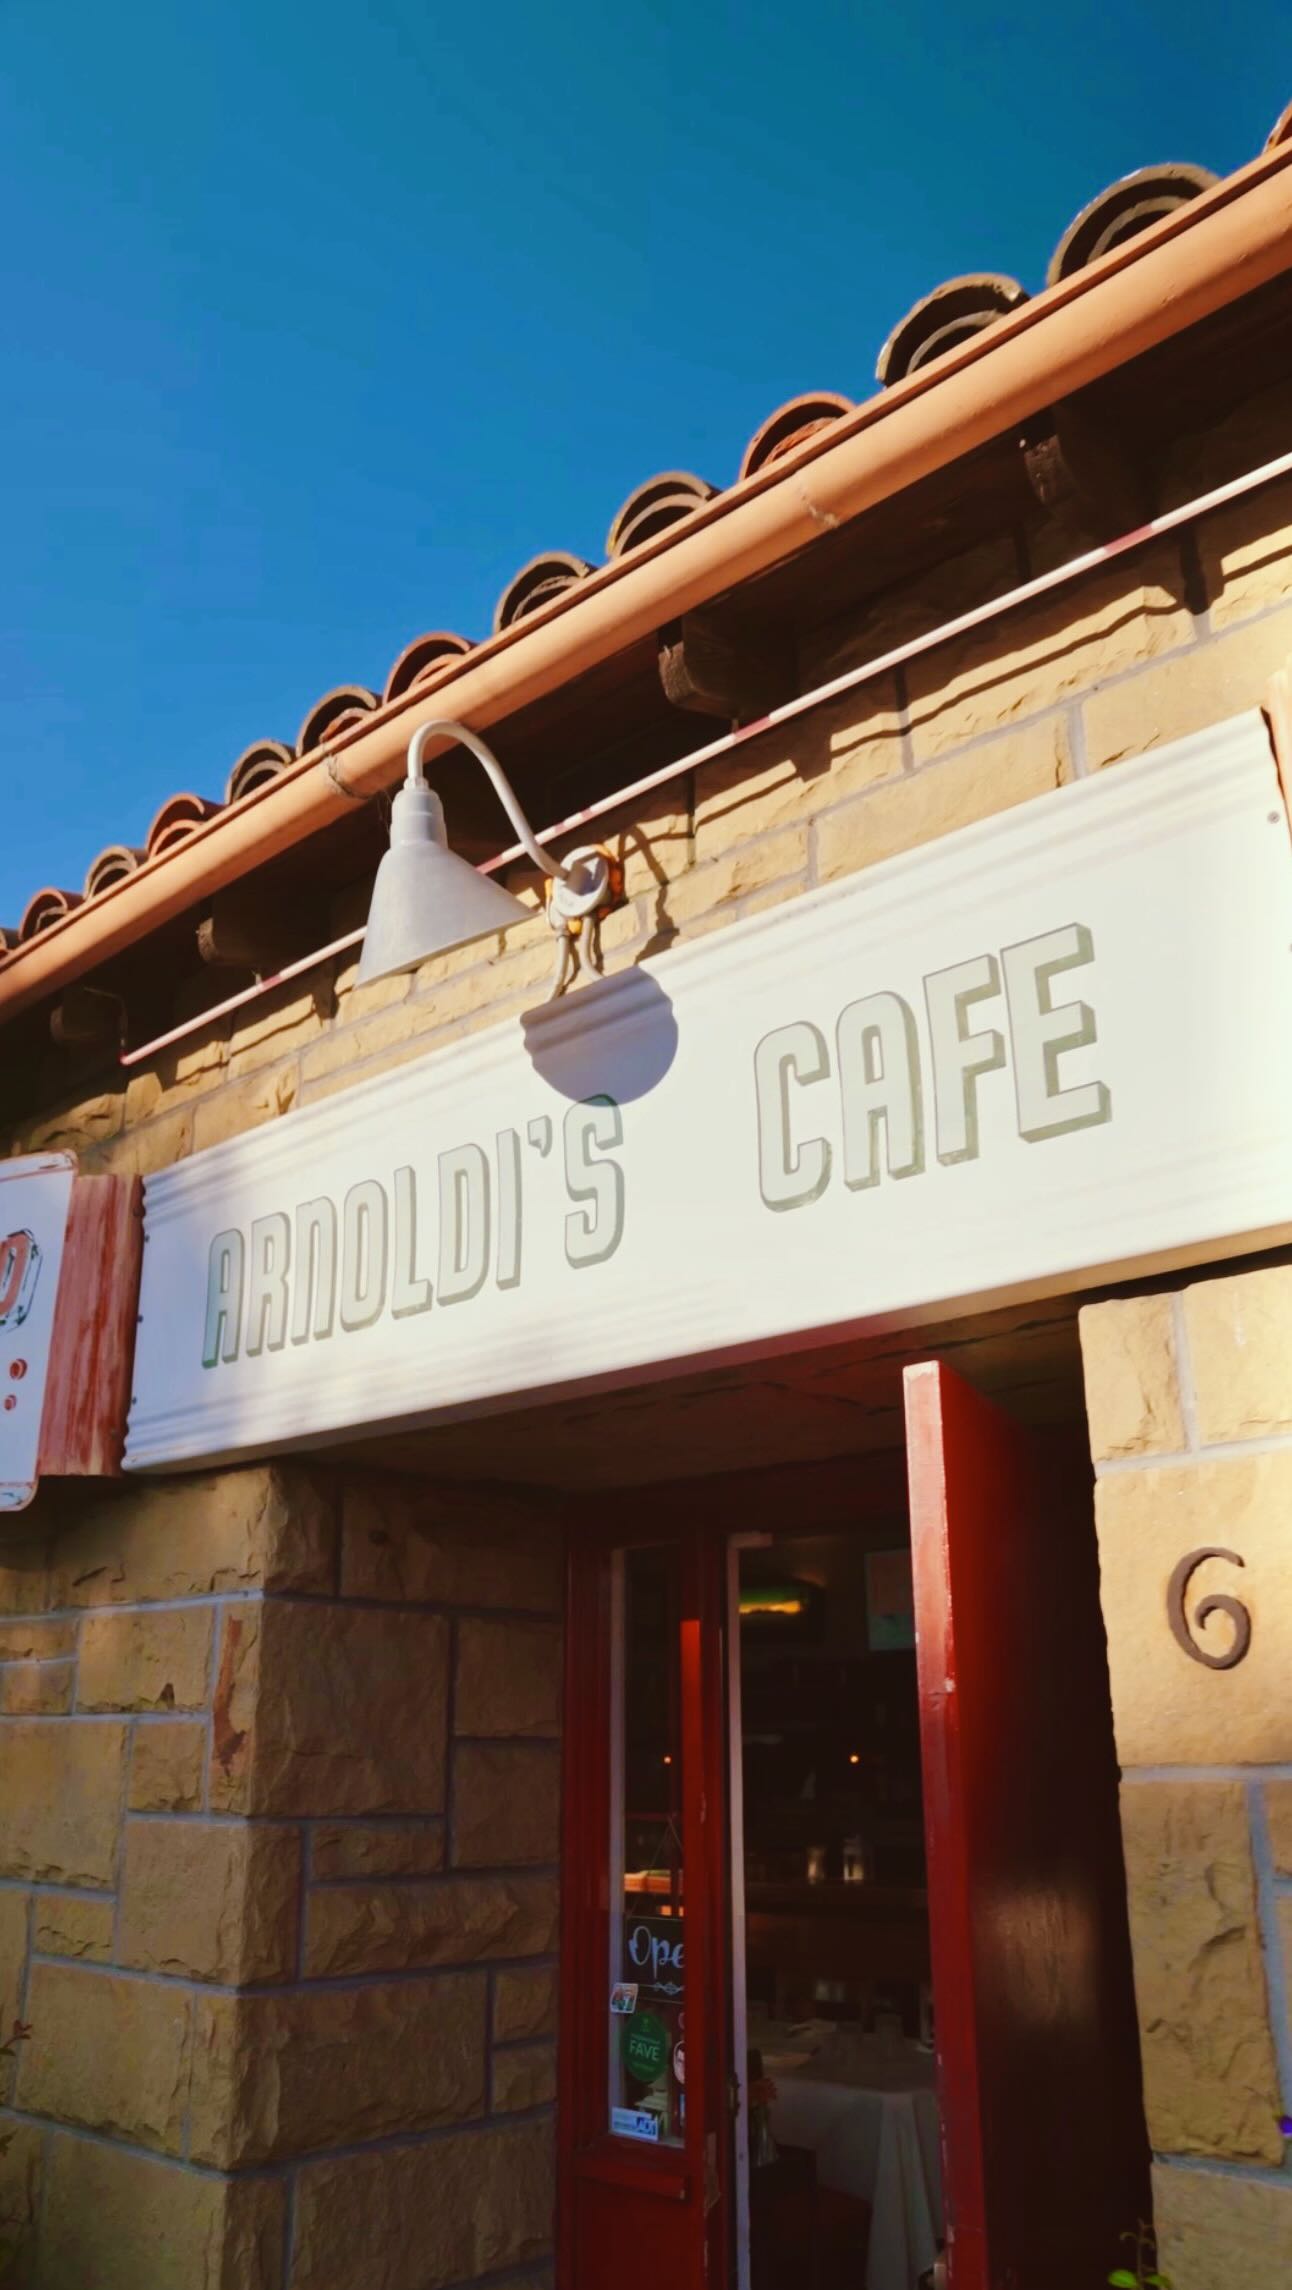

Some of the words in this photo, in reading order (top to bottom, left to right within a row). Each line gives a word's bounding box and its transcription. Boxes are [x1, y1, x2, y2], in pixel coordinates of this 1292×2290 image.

[202, 1093, 625, 1369] ARNOLDI'S
[753, 922, 1112, 1213] CAFE
[1166, 1547, 1252, 1670] 6
[630, 2039, 660, 2062] FAVE
